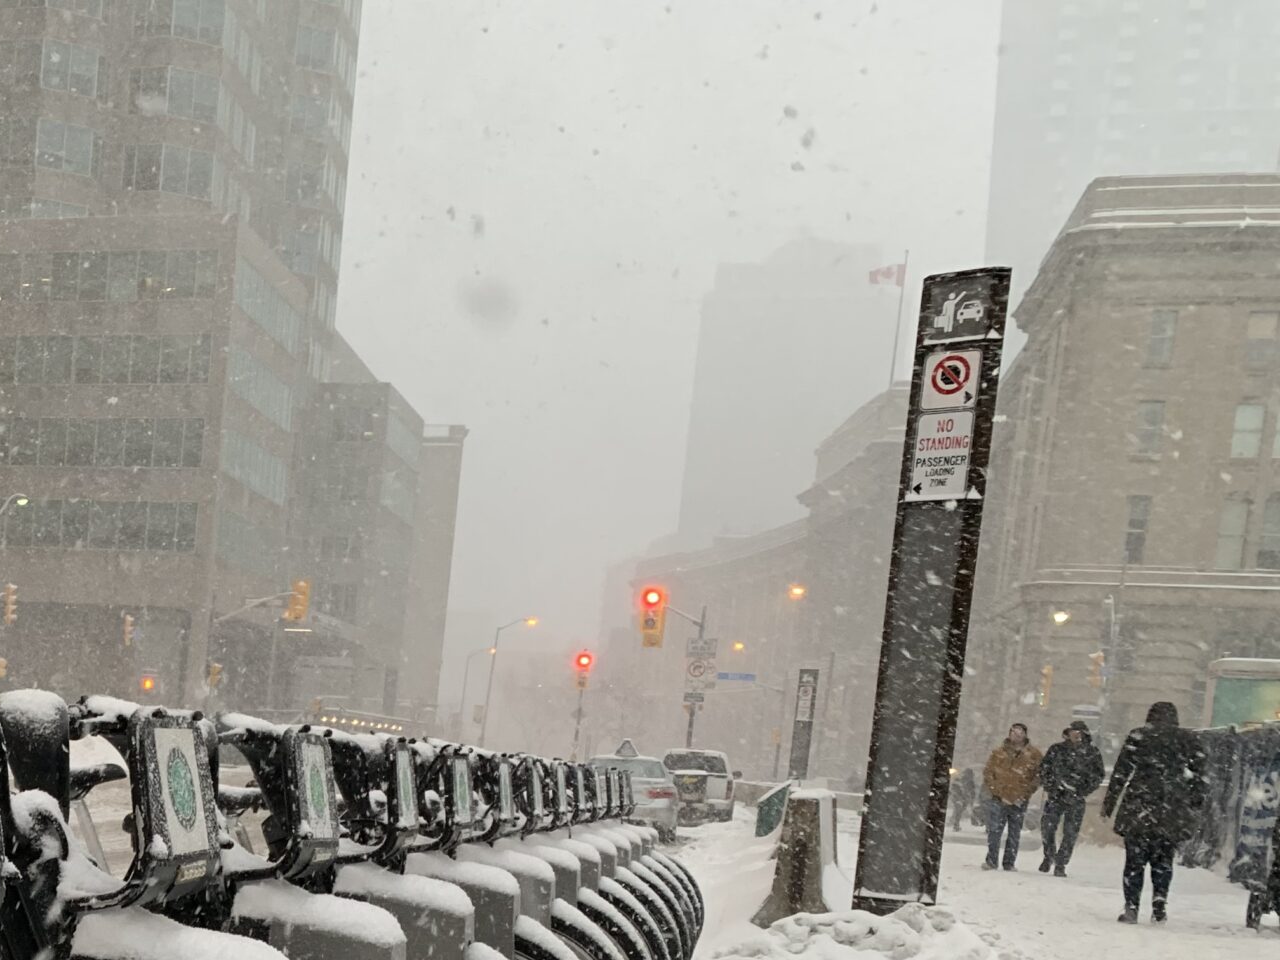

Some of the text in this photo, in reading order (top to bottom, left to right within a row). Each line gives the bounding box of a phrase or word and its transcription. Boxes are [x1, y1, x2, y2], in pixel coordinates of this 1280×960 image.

[937, 418, 954, 433] NO
[918, 435, 969, 452] STANDING
[916, 455, 967, 468] PASSENGER
[925, 467, 955, 477] LOADING
[930, 478, 948, 488] ZONE
